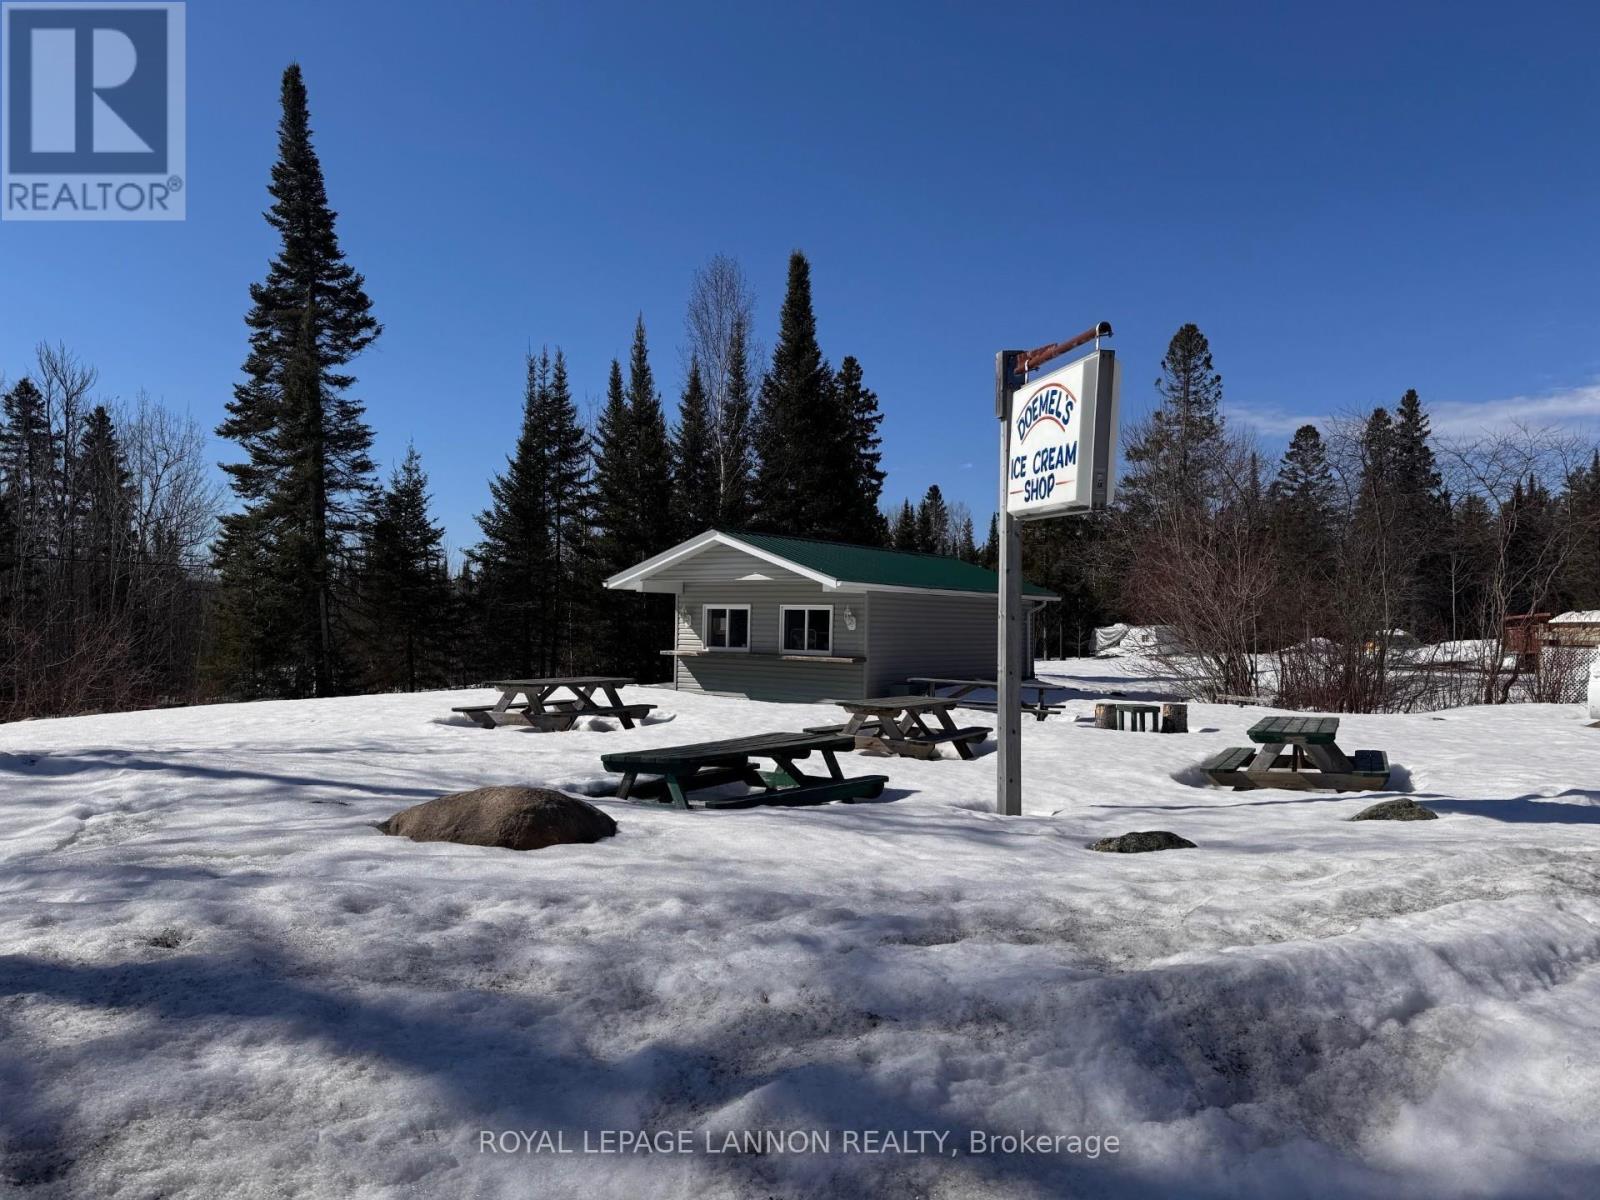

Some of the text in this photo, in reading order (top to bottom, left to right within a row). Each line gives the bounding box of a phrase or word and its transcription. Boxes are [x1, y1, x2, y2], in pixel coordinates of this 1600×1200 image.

[1017, 389, 1074, 441] DOEMEL'S
[1010, 441, 1077, 480] ICE CREAM
[1024, 473, 1056, 503] SHOP
